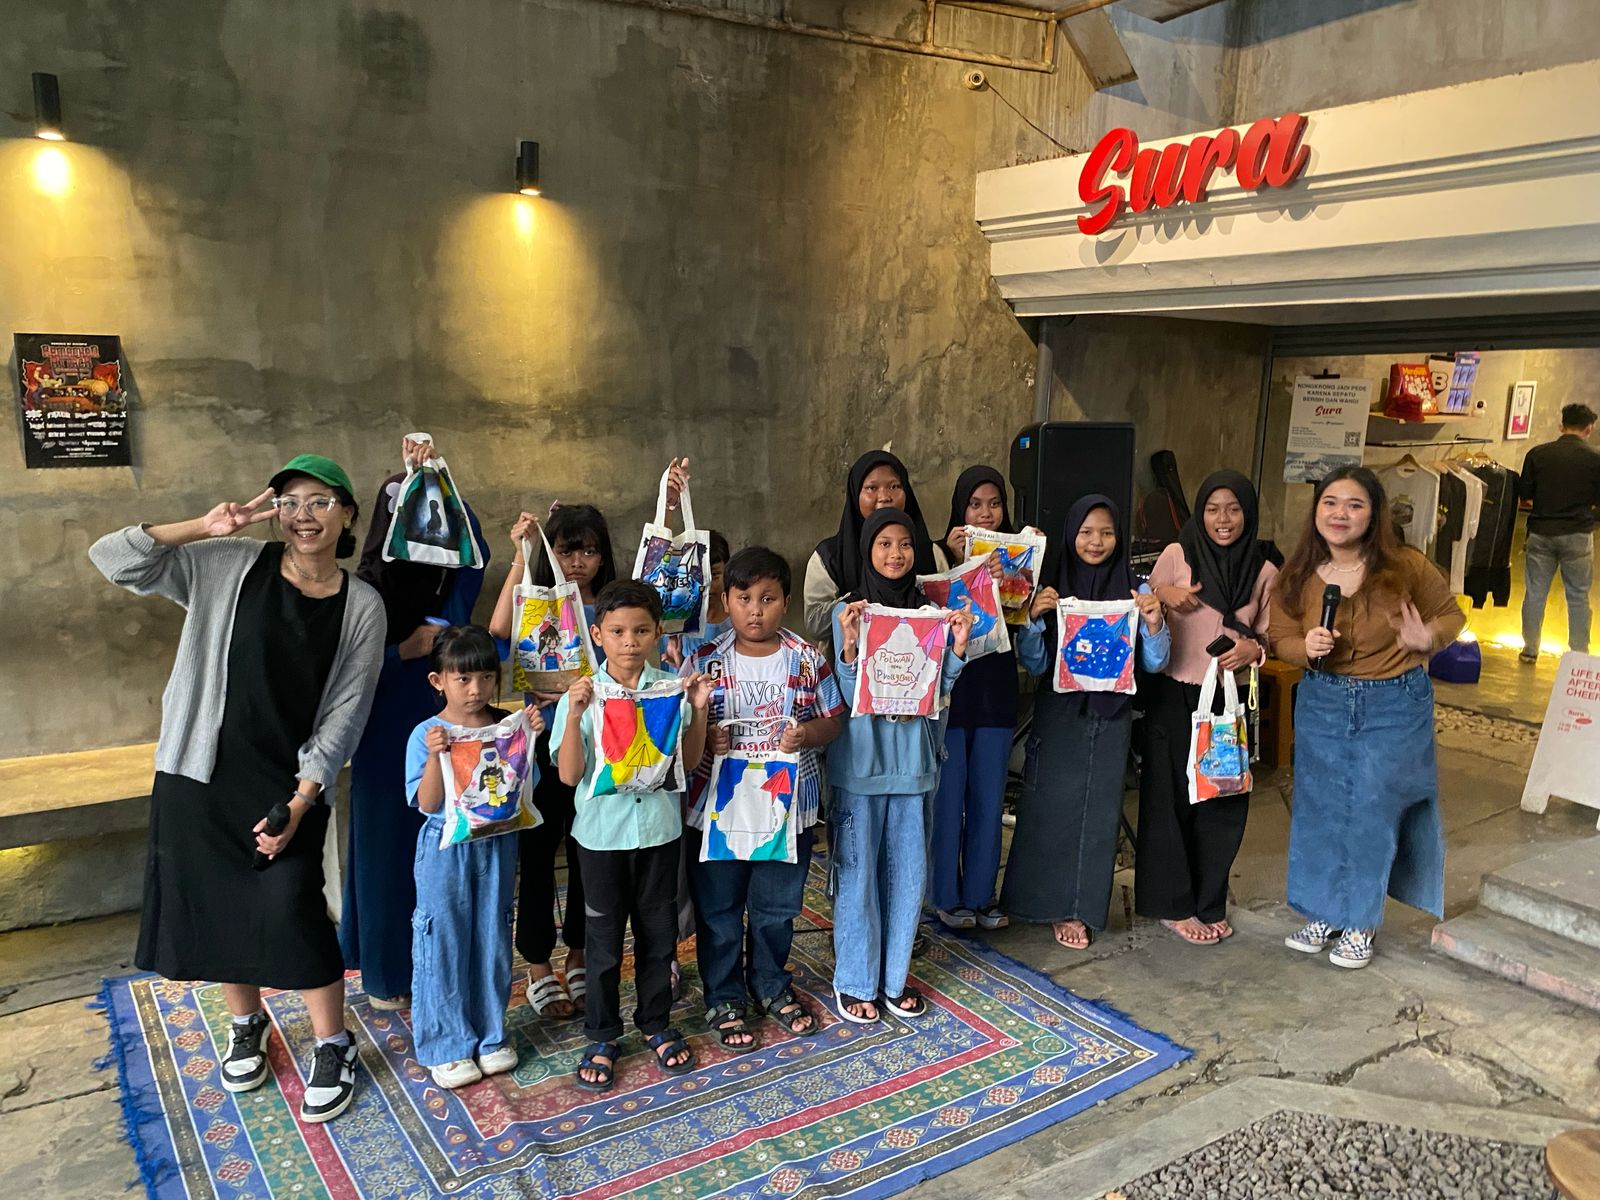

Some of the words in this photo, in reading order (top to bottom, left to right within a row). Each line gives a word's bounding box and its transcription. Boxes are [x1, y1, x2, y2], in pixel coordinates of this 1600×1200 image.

[1077, 112, 1311, 235] Sura
[1315, 405, 1342, 416] Sura
[707, 660, 722, 680] G
[1571, 668, 1593, 679] LIFE
